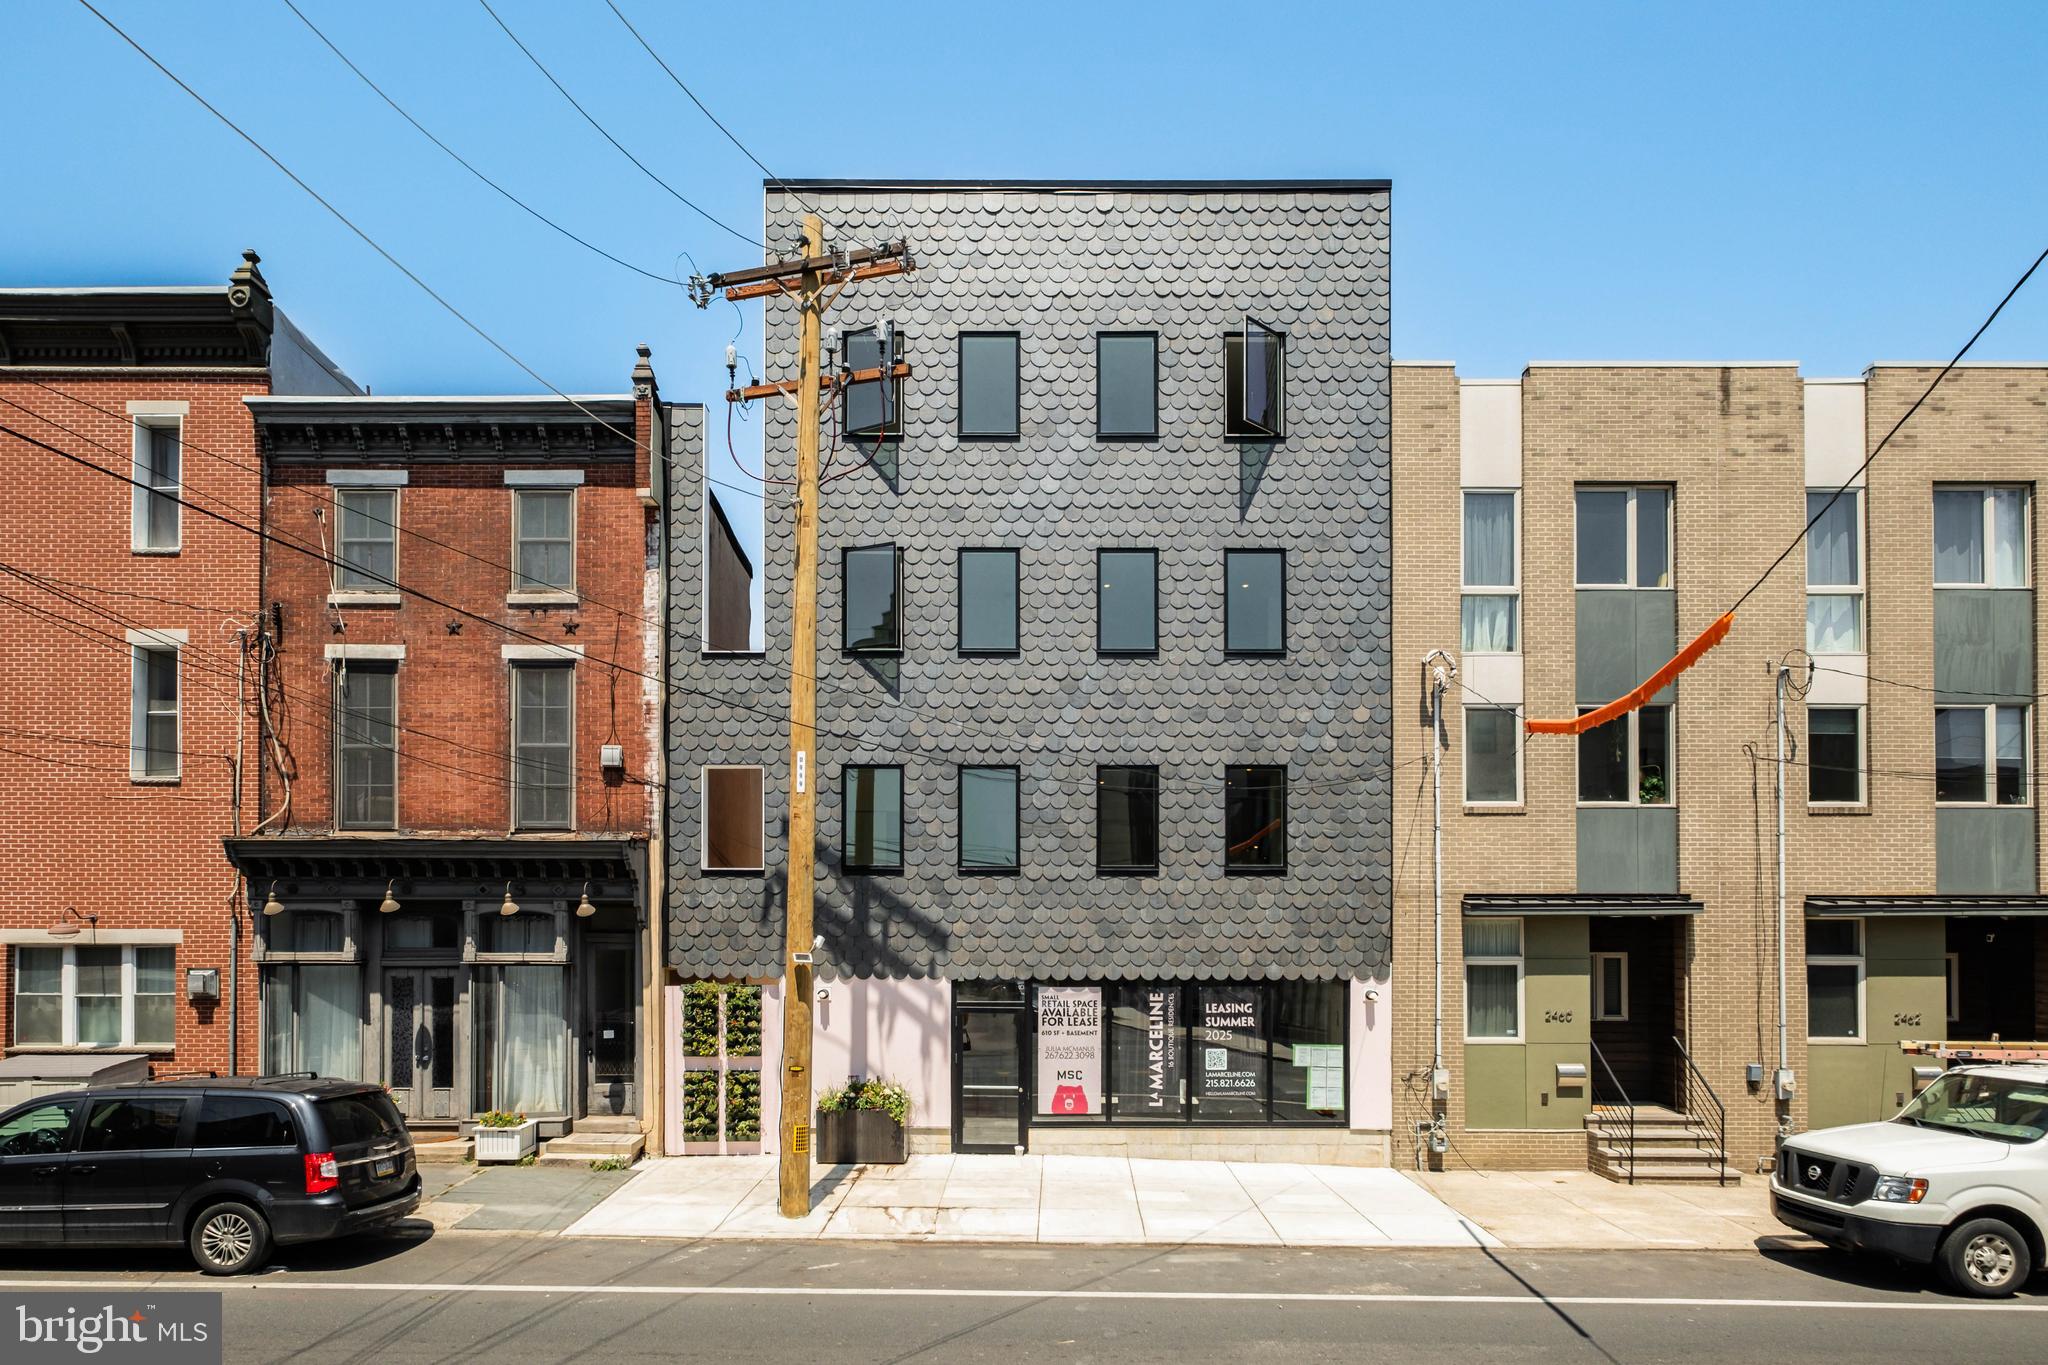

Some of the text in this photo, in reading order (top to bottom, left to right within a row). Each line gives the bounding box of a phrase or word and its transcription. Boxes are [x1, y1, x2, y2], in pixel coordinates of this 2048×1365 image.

[1041, 1000, 1098, 1008] RETAIL SPACE
[1205, 1003, 1253, 1013] LEASING
[1041, 1008, 1098, 1017] AVAILABLE
[1167, 992, 1175, 1027] RESIDENCES
[1041, 1017, 1098, 1026] FOR LEASE
[1205, 1016, 1255, 1027] SUMMER
[1205, 1030, 1233, 1041] 2025
[1149, 992, 1164, 1090] MARCELINE
[1167, 1027, 1175, 1060] BOUTIQUE
[1057, 1070, 1083, 1080] MSC
[1205, 1079, 1256, 1088] 215.821.6626
